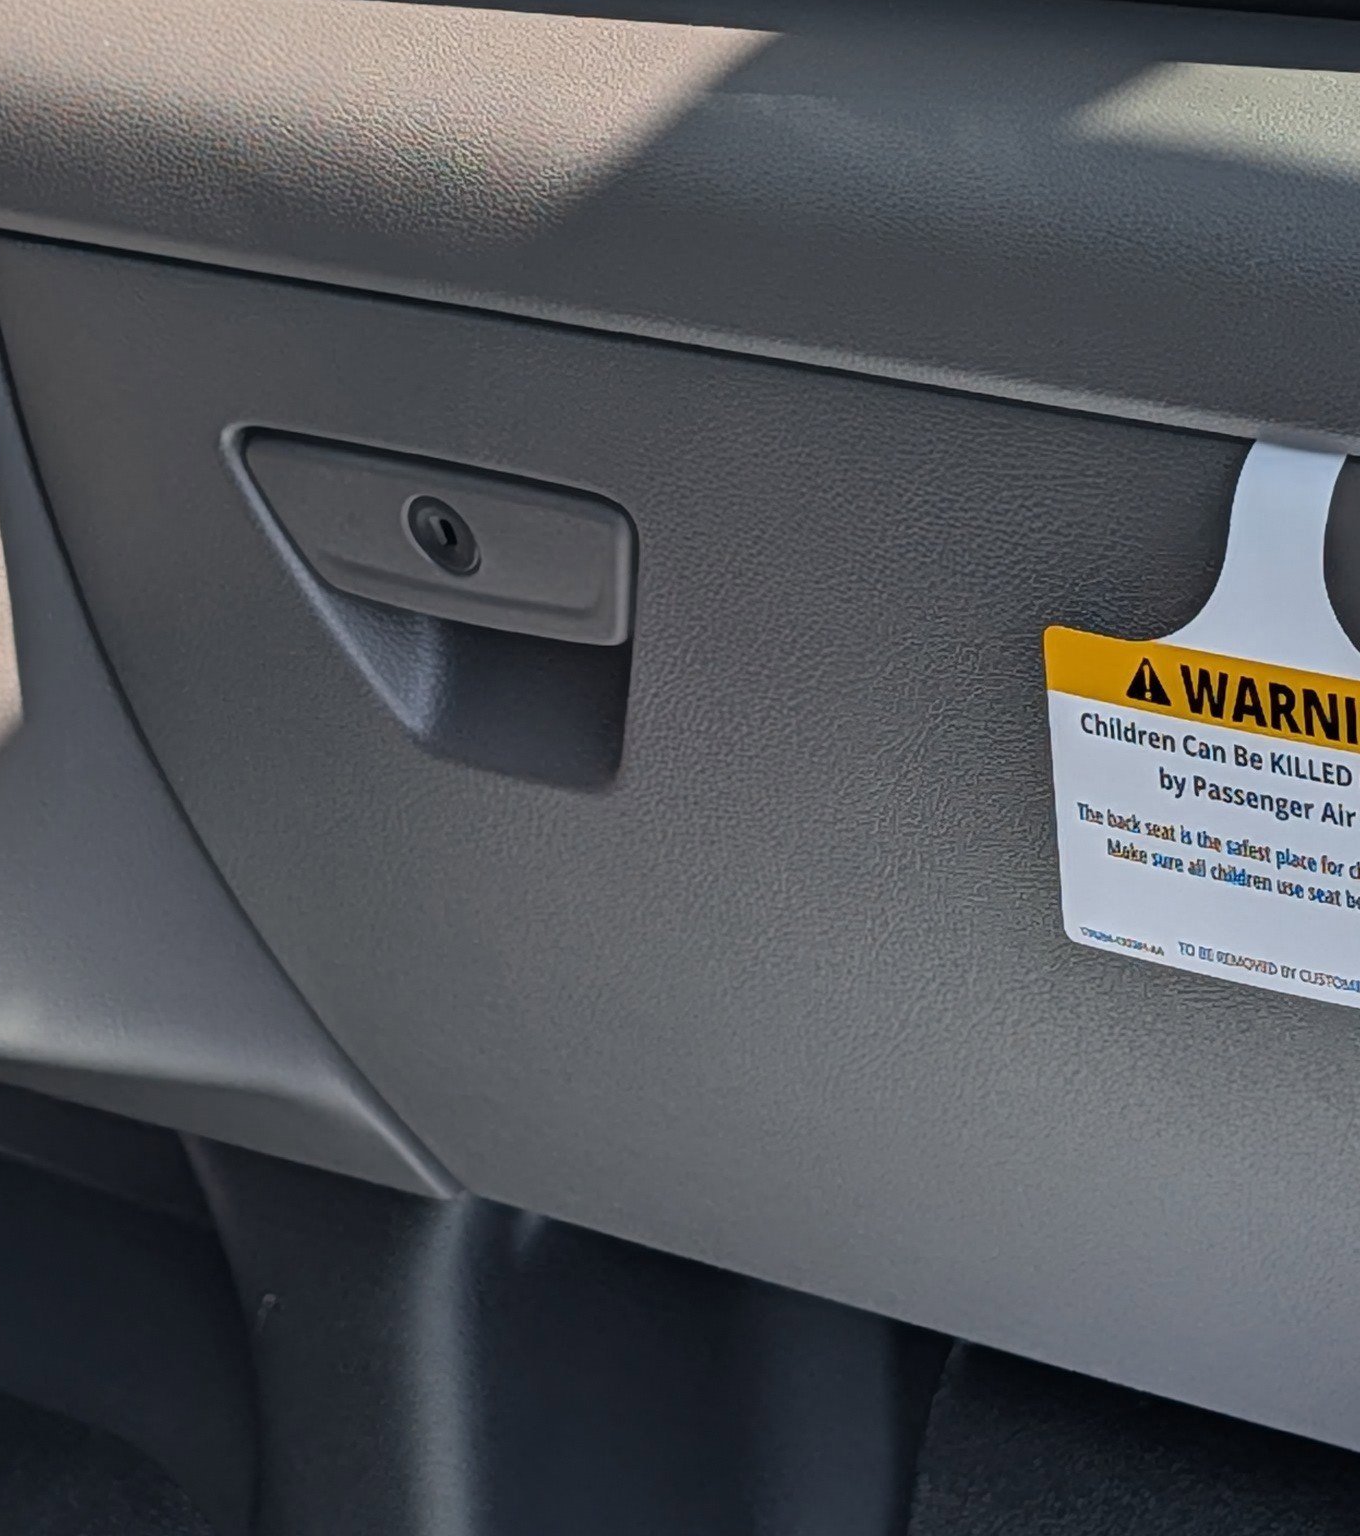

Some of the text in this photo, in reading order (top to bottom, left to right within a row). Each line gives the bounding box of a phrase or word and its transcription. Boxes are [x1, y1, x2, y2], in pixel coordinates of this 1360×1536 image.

[1080, 712, 1176, 753] Children
[1183, 734, 1227, 763] Can
[1233, 744, 1264, 770] Be
[1270, 751, 1353, 787] KILLED
[1158, 766, 1186, 799] by
[1193, 775, 1315, 822] Passenger
[1321, 802, 1356, 828] Air
[1077, 802, 1104, 825] The
[1107, 809, 1141, 834] back
[1145, 821, 1176, 842] seat
[1180, 825, 1192, 845] is
[1197, 830, 1222, 852] the
[1226, 838, 1271, 863] safest
[1276, 847, 1318, 873] place
[1321, 854, 1344, 877] for
[1107, 838, 1148, 864] Make
[1151, 851, 1184, 873] sure
[1188, 858, 1206, 878] all
[1210, 863, 1272, 892] children
[1277, 878, 1304, 899] use
[1308, 885, 1342, 907] seat
[1178, 941, 1195, 956] TO
[1281, 965, 1297, 979] BY
